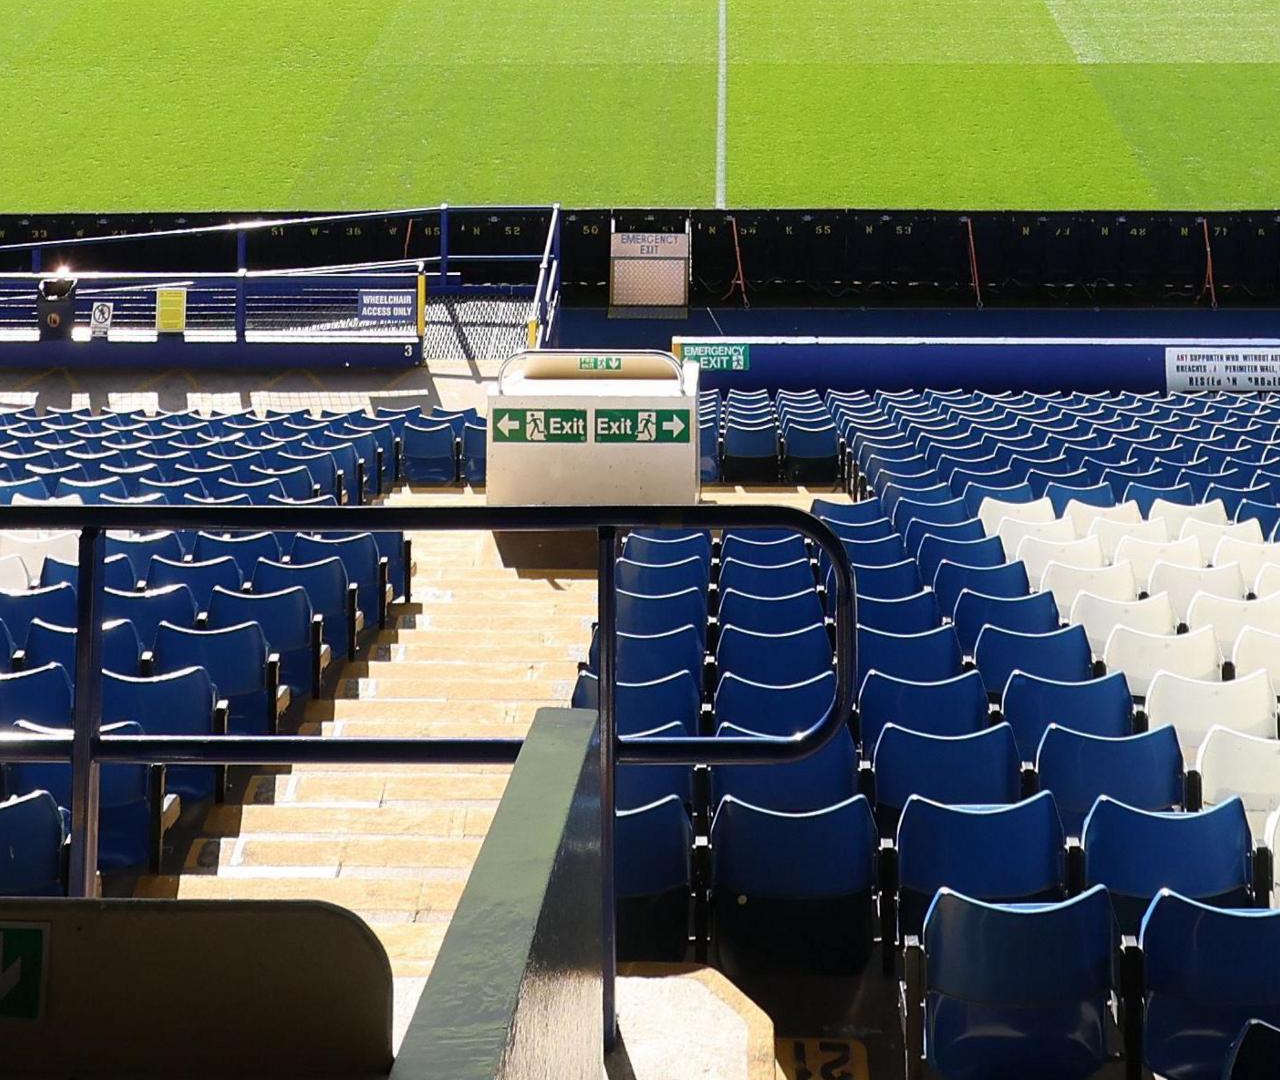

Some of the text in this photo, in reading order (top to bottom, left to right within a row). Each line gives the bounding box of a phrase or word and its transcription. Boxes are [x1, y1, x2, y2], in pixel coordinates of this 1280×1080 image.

[620, 234, 679, 244] EMERGENCY
[640, 245, 659, 255] EXIT
[362, 295, 412, 305] WHEELCHAIR
[361, 306, 413, 316] ACCESS ONLY
[404, 344, 413, 357] 3
[683, 345, 745, 356] EMERGENCY
[700, 356, 730, 369] EXIT
[1189, 353, 1224, 362] SUPPORTER
[1242, 353, 1269, 362] WITHOUT
[1224, 365, 1258, 373] PERIMETER
[549, 417, 585, 435] Exit
[596, 417, 632, 435] Exit
